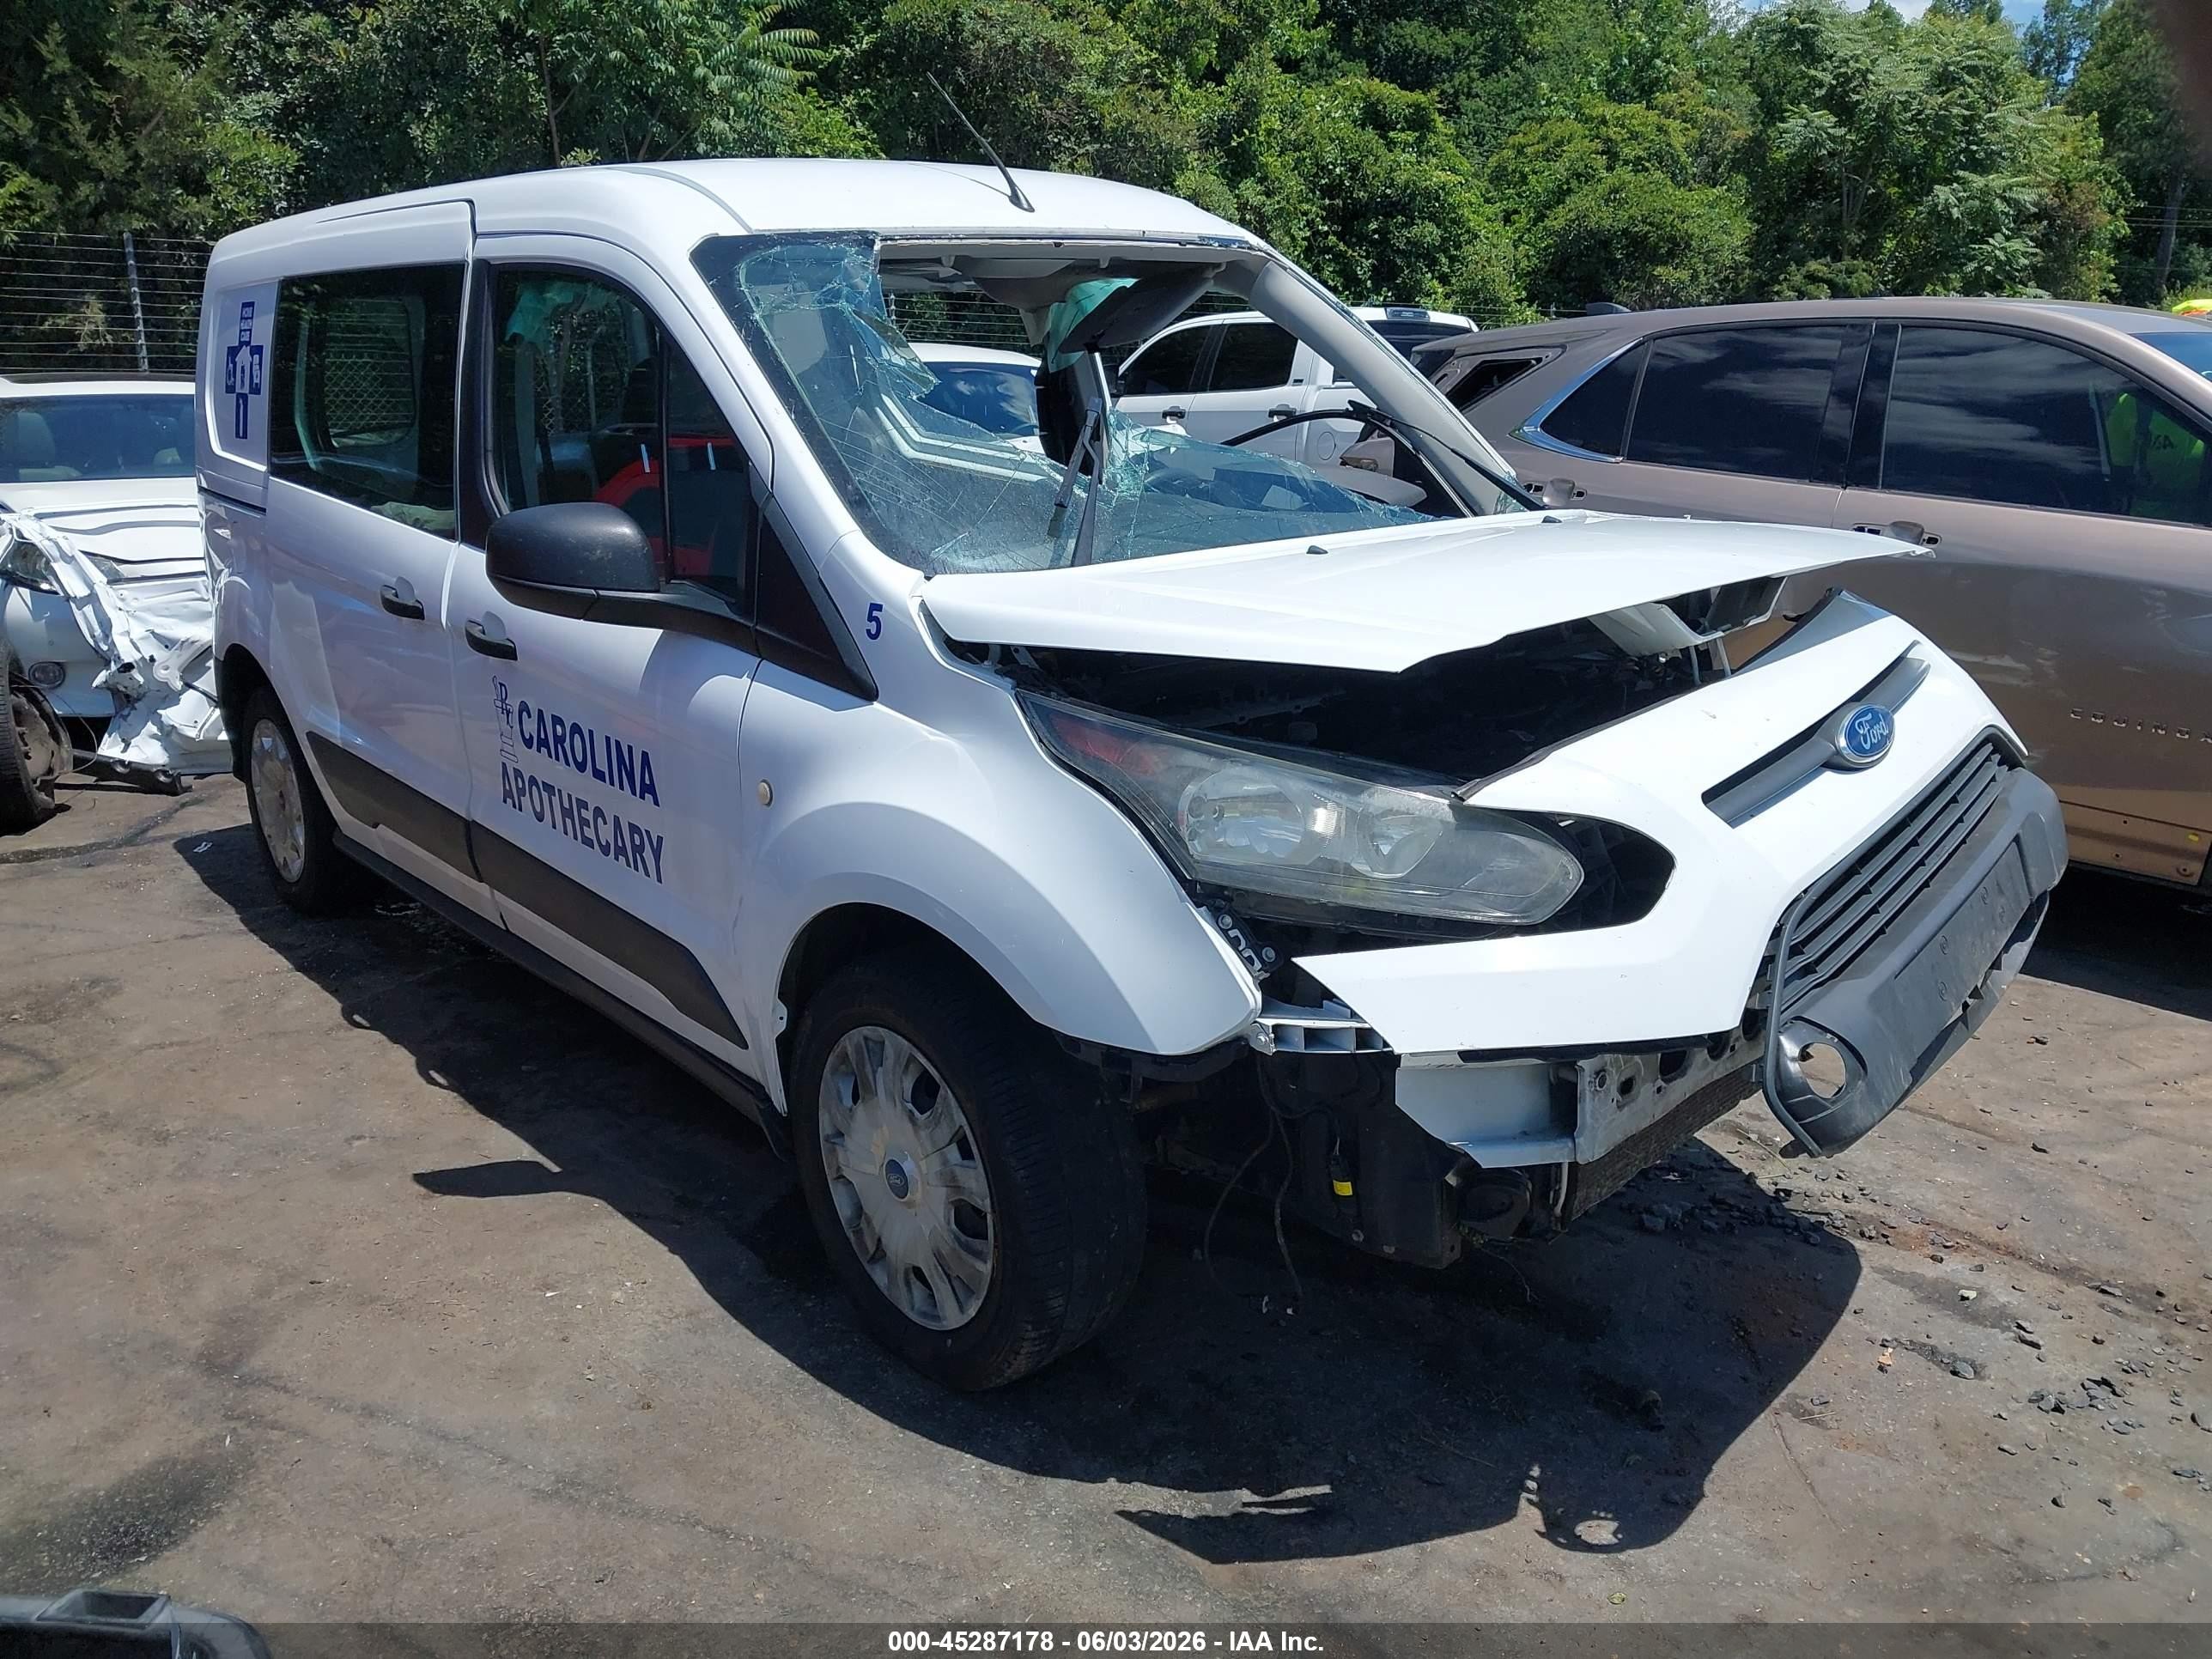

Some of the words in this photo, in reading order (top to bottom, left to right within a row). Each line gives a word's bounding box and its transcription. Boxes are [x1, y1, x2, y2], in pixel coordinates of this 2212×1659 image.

[866, 602, 884, 641] 5
[518, 700, 660, 808] CAROLINA
[1855, 712, 1889, 750] Ford
[501, 761, 664, 884] APOTHECARY
